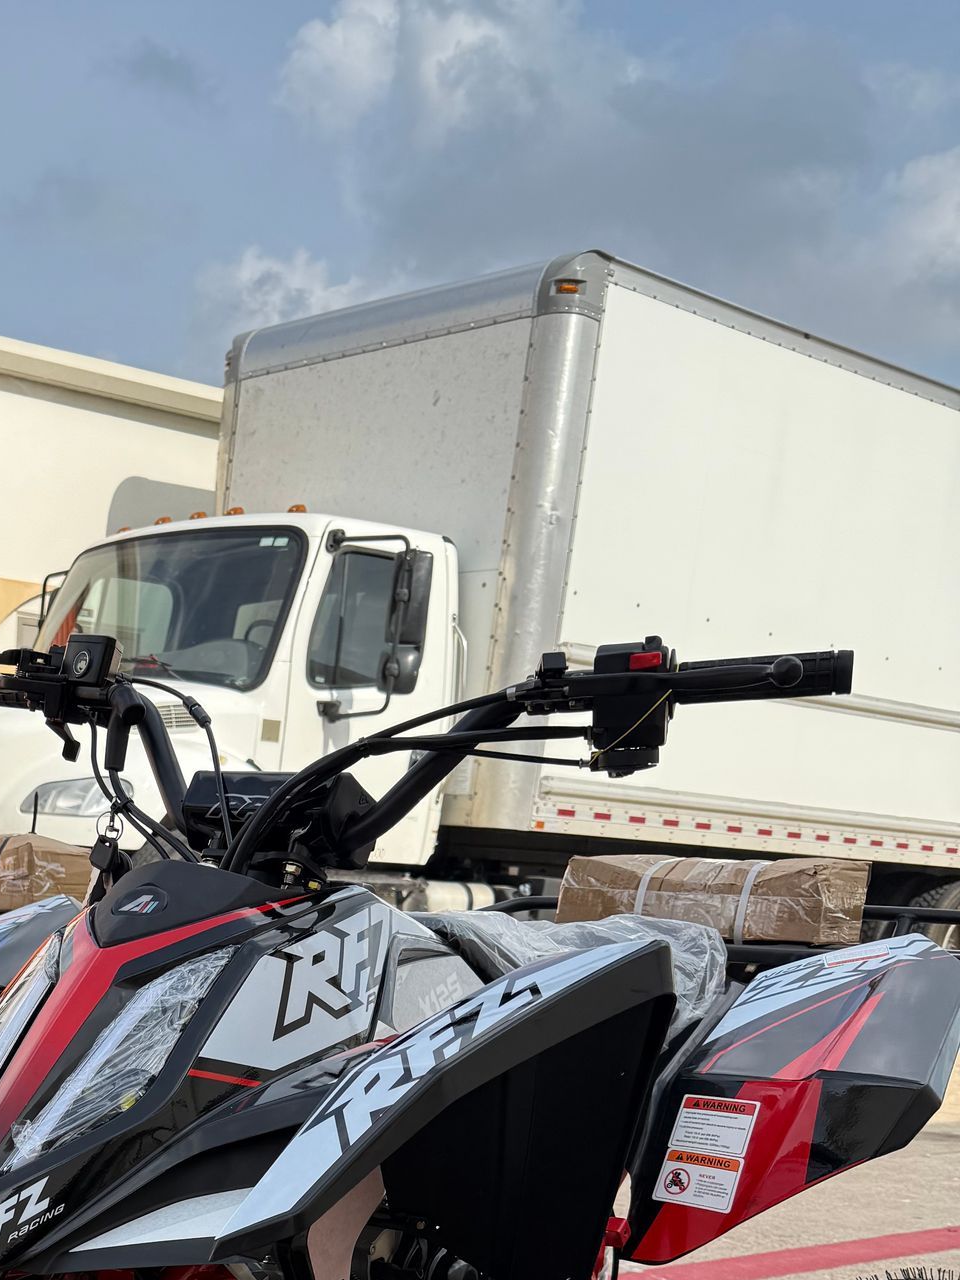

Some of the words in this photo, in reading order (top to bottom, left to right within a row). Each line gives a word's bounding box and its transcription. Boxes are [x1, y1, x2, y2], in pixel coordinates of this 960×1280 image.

[323, 978, 540, 1146] RFZ
[702, 1100, 746, 1113] WARNING
[686, 1154, 731, 1168] WARNING
